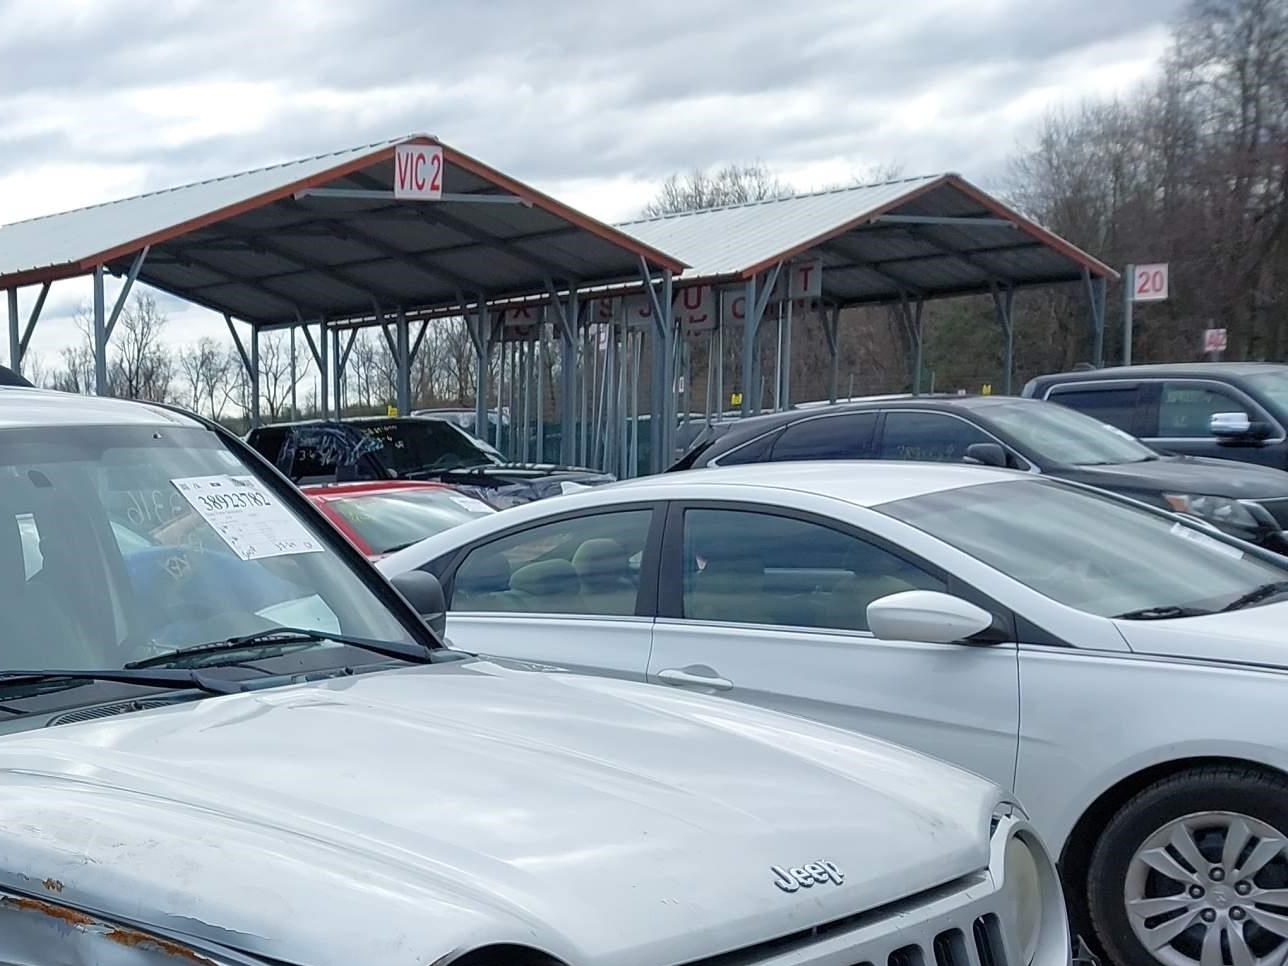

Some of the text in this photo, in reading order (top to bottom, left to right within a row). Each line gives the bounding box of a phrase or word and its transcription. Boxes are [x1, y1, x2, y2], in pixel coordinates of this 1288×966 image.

[397, 152, 441, 192] VIC 2
[799, 267, 814, 291] T
[1137, 270, 1165, 294] 20
[198, 492, 271, 512] 38923782
[770, 859, 845, 893] Jeep
